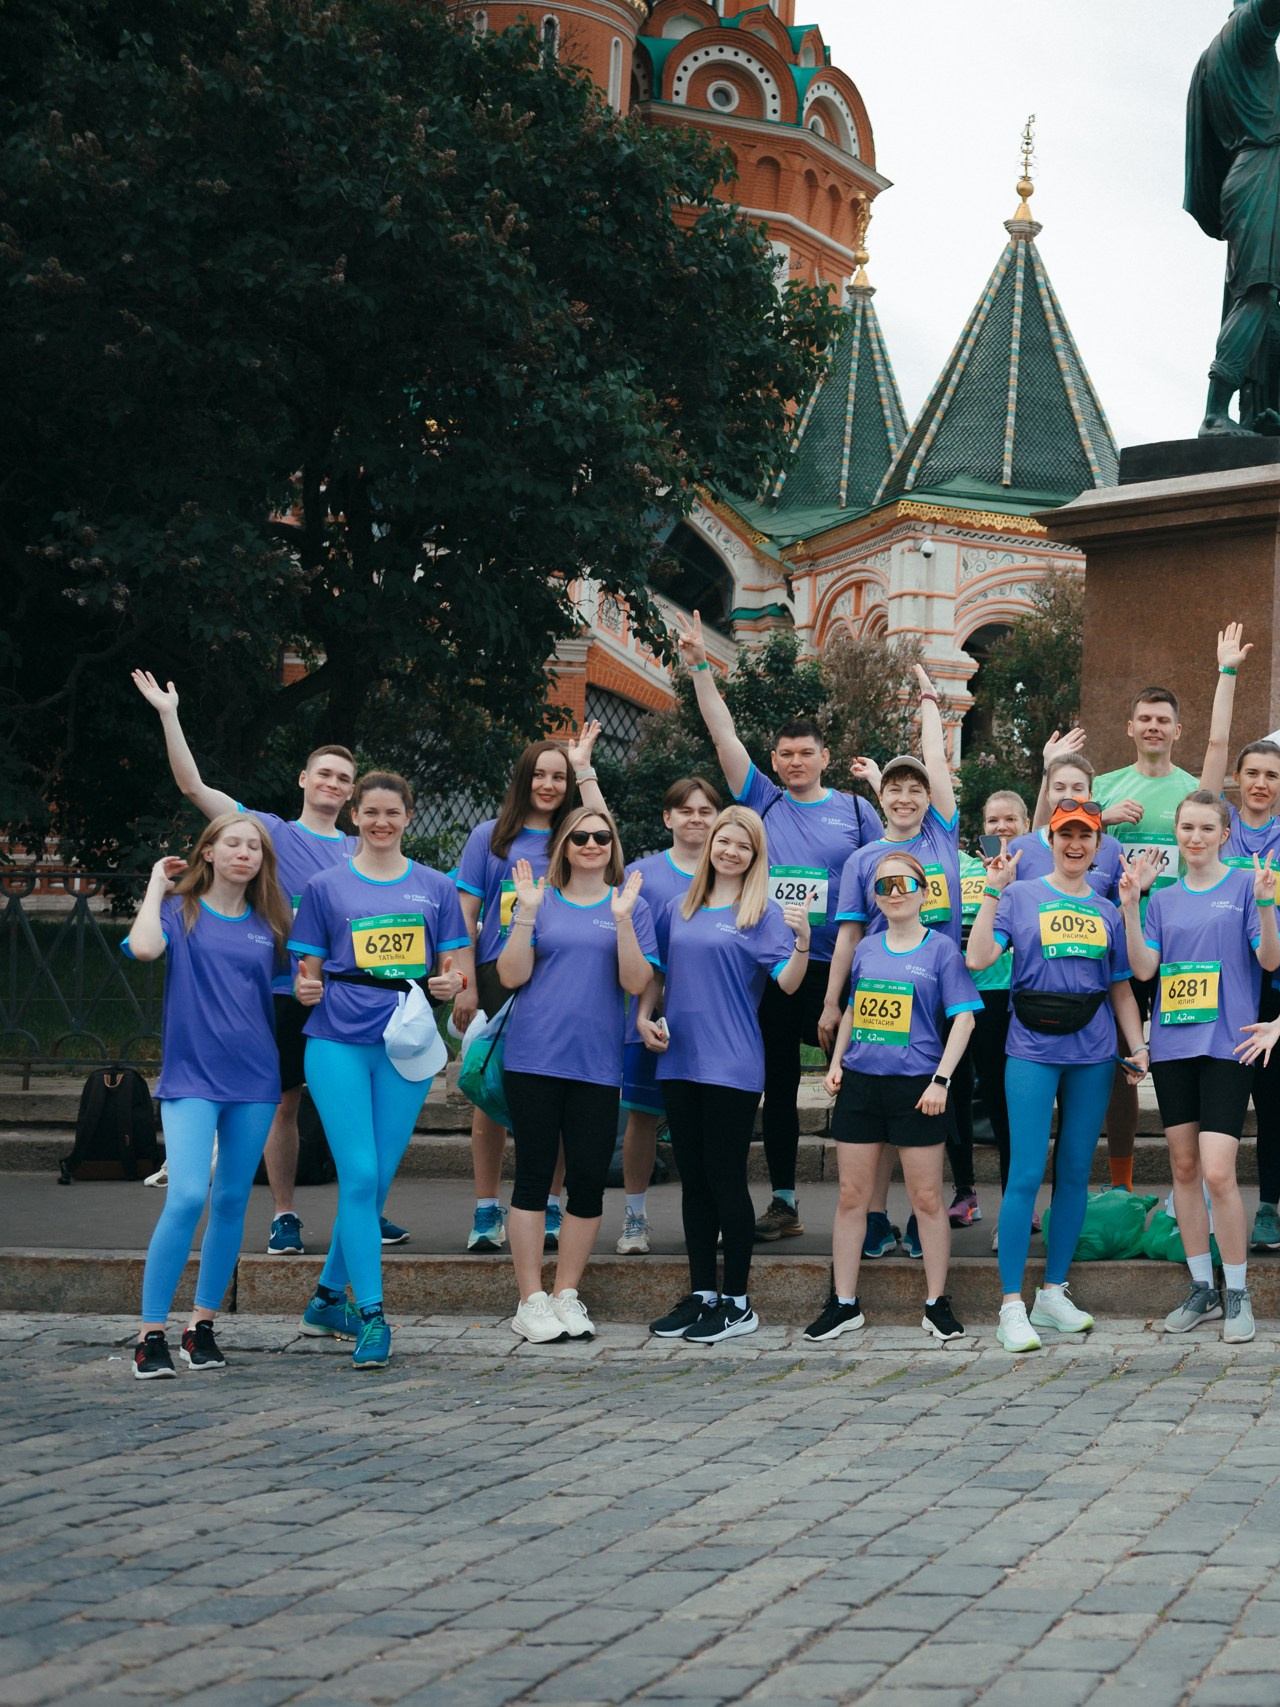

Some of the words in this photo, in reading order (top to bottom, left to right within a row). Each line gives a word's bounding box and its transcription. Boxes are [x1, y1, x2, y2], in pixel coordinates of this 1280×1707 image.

[775, 883, 819, 901] 6284
[1050, 915, 1097, 933] 6093
[365, 932, 415, 954] 6287
[1048, 945, 1057, 956] D
[1168, 979, 1208, 999] 6281
[860, 997, 902, 1019] 6263
[863, 1018, 895, 1026] АНАСТАСИЯ
[1164, 1013, 1171, 1023] D
